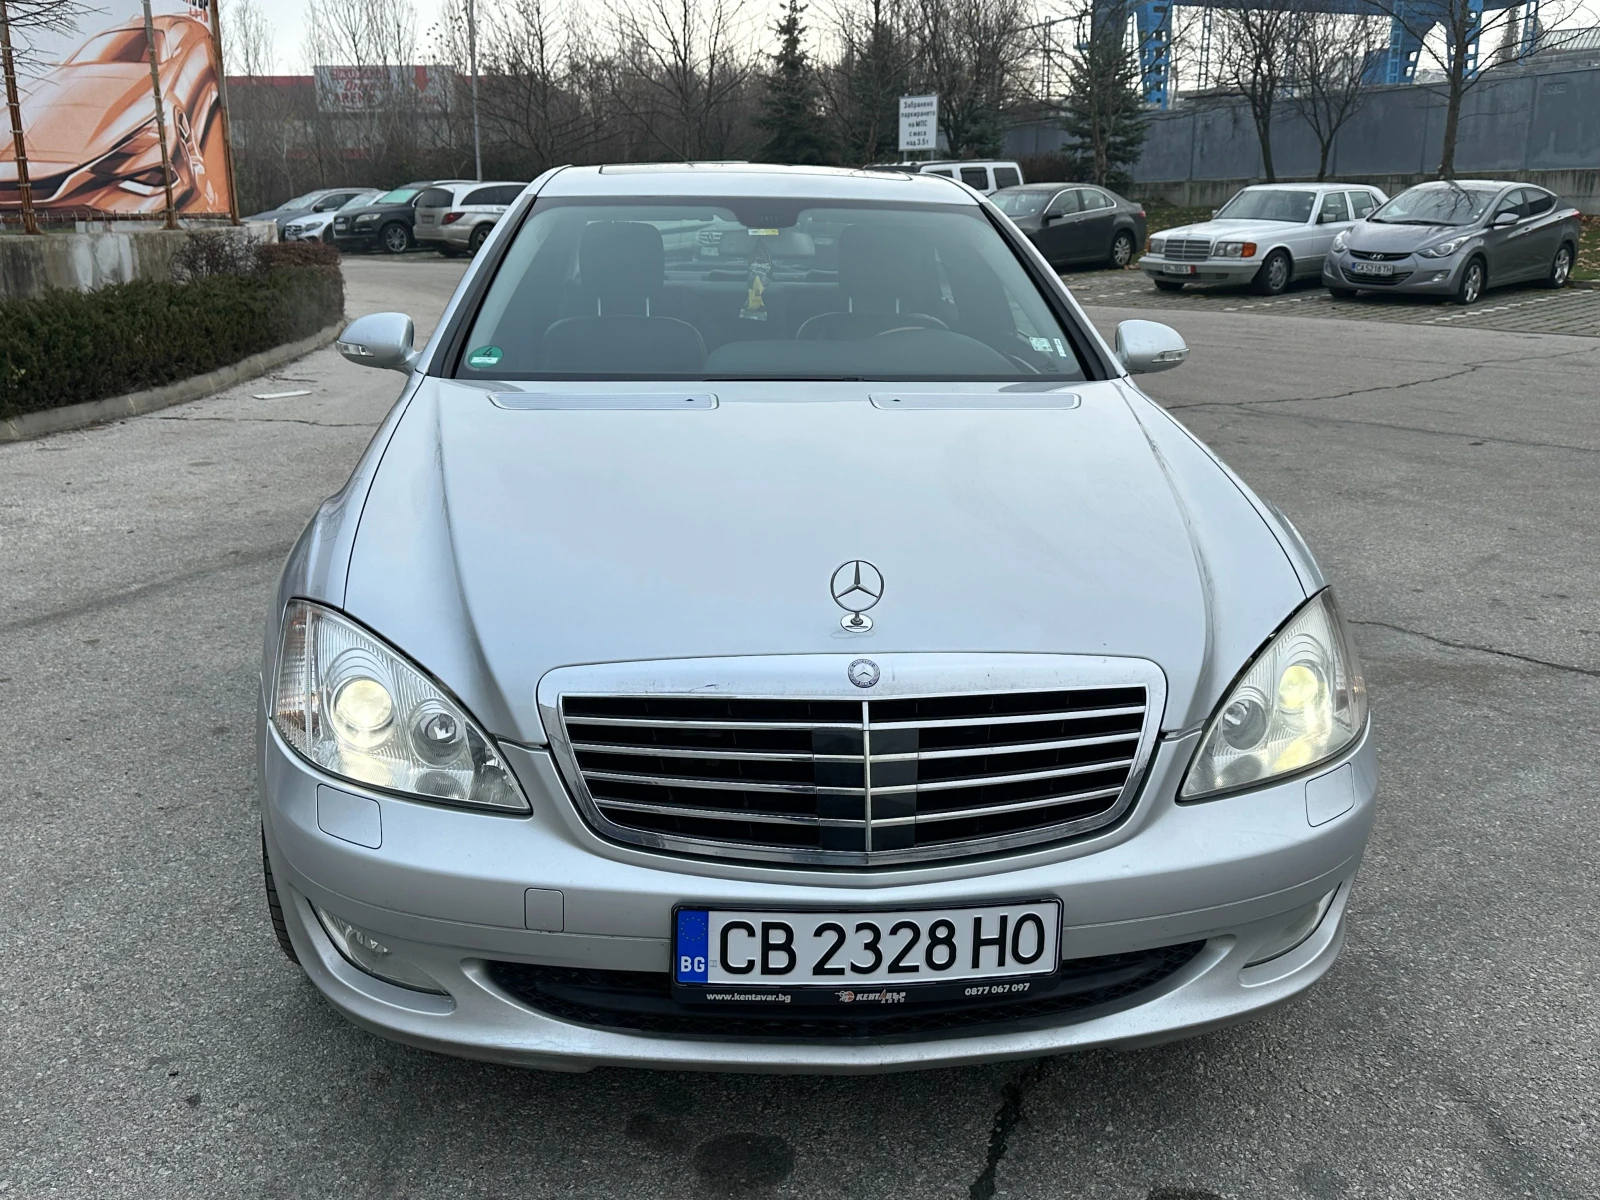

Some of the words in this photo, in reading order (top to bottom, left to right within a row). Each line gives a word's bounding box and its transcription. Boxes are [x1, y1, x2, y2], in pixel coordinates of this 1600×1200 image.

[903, 101, 934, 109] Забранено
[482, 346, 494, 358] 4
[719, 920, 798, 976] CB
[811, 918, 958, 977] 2328
[680, 955, 706, 973] BG
[964, 986, 990, 996] 0877
[991, 984, 1010, 994] 067
[1011, 982, 1031, 992] 097
[706, 992, 791, 1003] www.kentavar.bg
